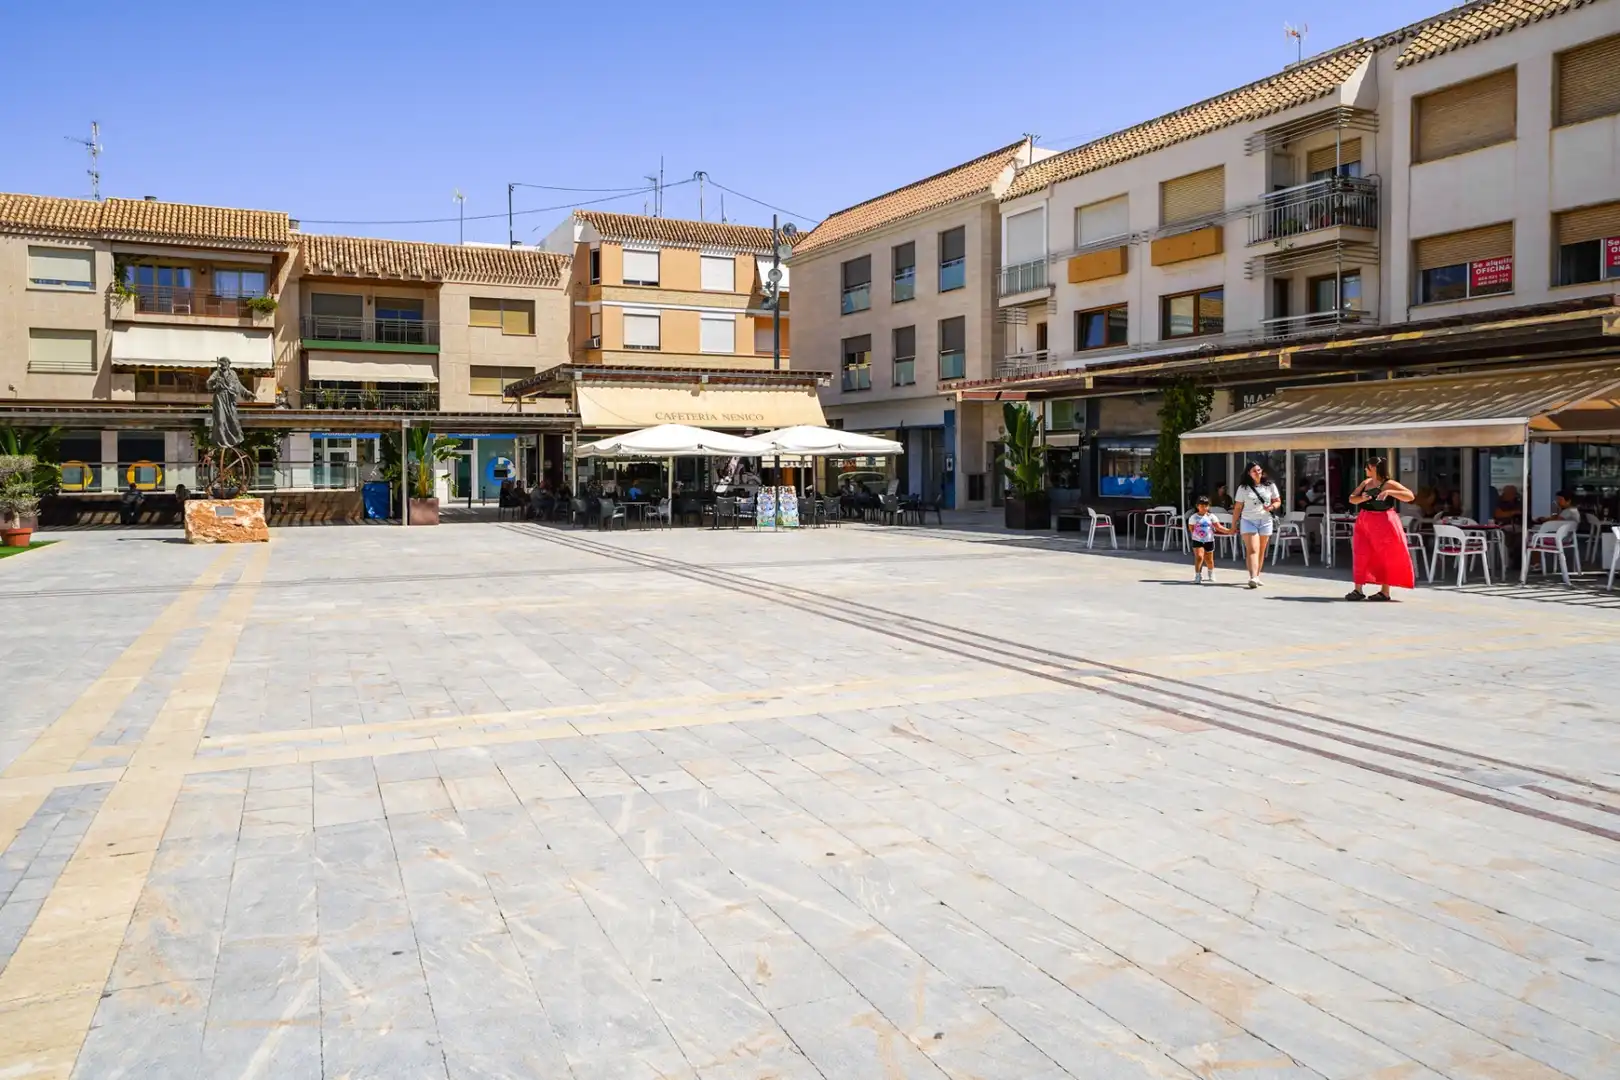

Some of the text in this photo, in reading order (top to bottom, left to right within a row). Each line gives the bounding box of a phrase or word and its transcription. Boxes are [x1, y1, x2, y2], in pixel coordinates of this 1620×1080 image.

[1475, 263, 1511, 275] OFICINA
[654, 411, 765, 422] CAFETERÍA NENICO
